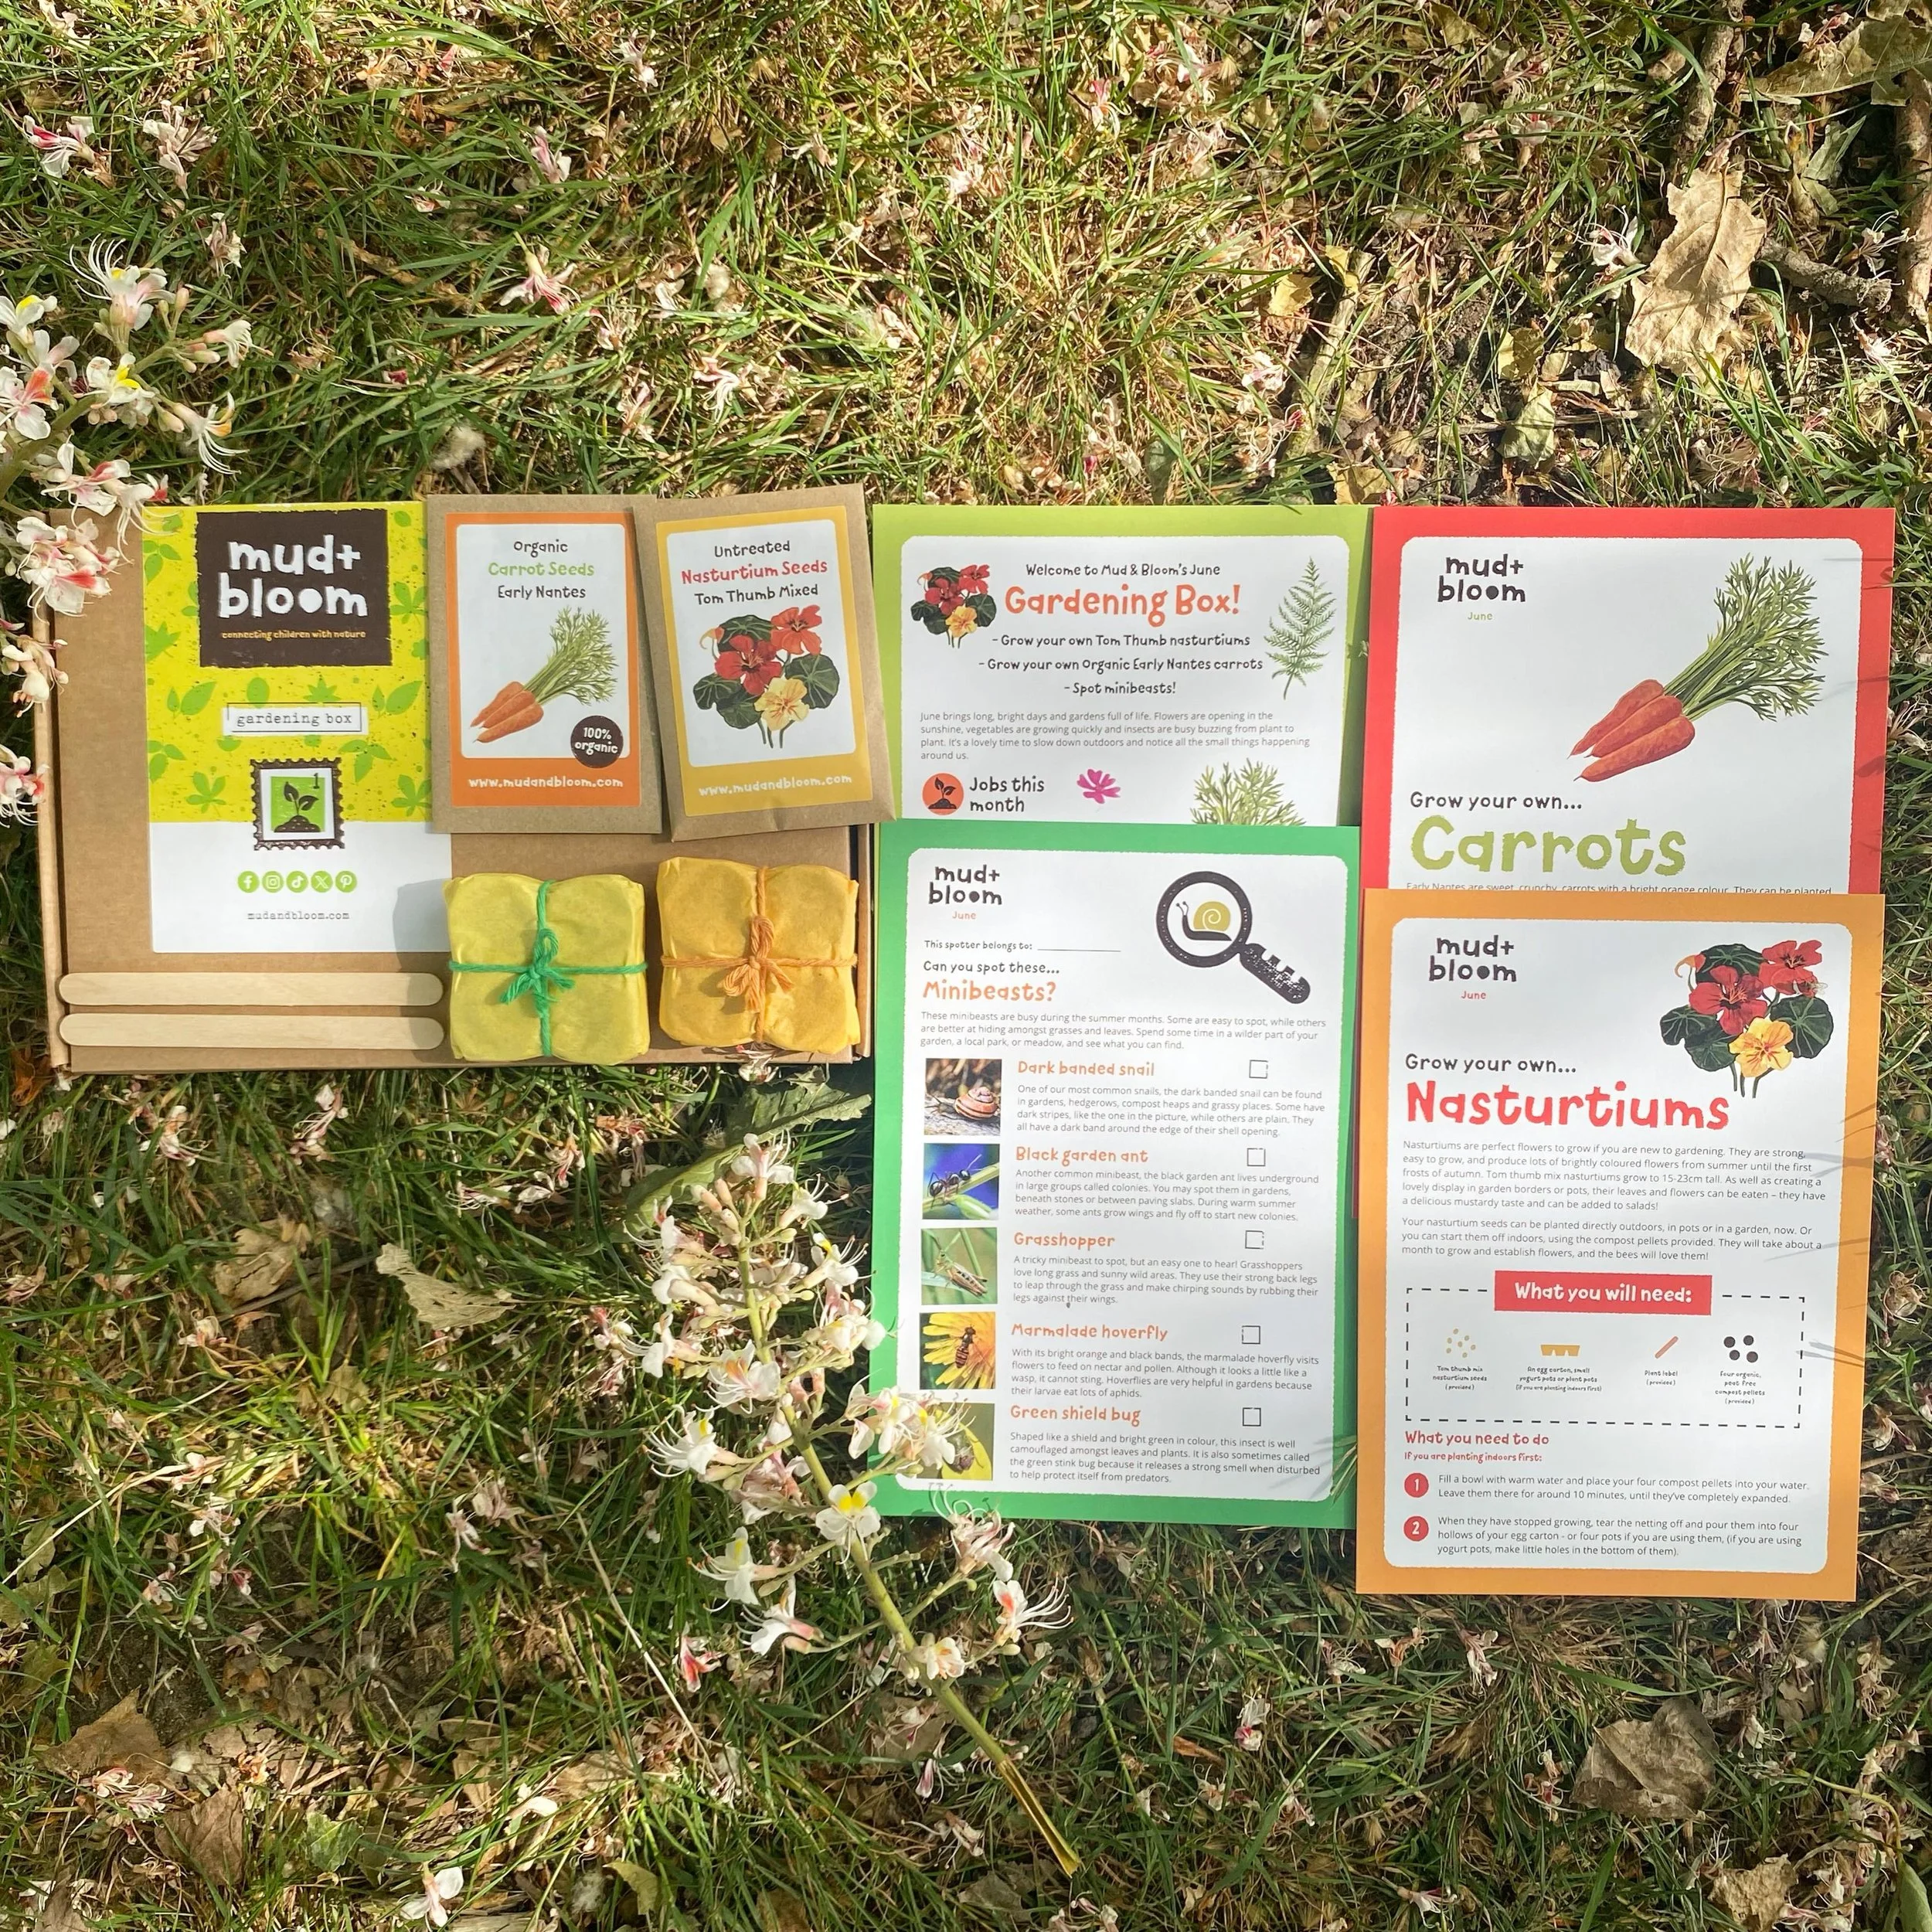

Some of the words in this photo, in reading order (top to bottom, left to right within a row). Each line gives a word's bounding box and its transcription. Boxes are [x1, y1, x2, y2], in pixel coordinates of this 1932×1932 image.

[229, 534, 361, 575] mud+
[514, 539, 568, 558] Organic
[714, 541, 791, 558] Untreated
[488, 562, 545, 576] Carrot
[549, 562, 594, 576] Seeds
[681, 563, 778, 584] Nasturtium
[782, 560, 828, 575] Seeds
[1026, 563, 1080, 577] Welcome
[1083, 564, 1097, 576] to
[1100, 565, 1127, 576] Mud
[1131, 564, 1138, 576] &
[1190, 564, 1220, 576] June
[1446, 553, 1523, 577] mud+
[218, 572, 368, 618] bloom
[498, 585, 532, 600] Early
[536, 585, 586, 598] Nantes
[695, 594, 723, 605] Tom
[726, 587, 776, 603] Thumb
[779, 583, 818, 598] Mixed
[1437, 575, 1526, 603] bloom
[1005, 583, 1168, 628] Gardening
[1175, 584, 1240, 615] Box!
[1468, 611, 1493, 621] June
[222, 630, 272, 641] connecting
[274, 629, 310, 638] children
[311, 629, 332, 638] with
[334, 630, 366, 638] nature
[1001, 634, 1034, 646] Grow
[1036, 638, 1066, 648] your
[1069, 638, 1093, 646] own
[1095, 635, 1121, 646] Tom
[1124, 634, 1167, 646] Thumb
[1170, 633, 1250, 646] nasturtiums
[988, 658, 1020, 670] Grow
[1022, 662, 1053, 672] your
[1055, 662, 1079, 670] own
[1082, 658, 1130, 675] Organic
[1133, 658, 1164, 672] Early
[1167, 658, 1211, 670] Nantes
[1214, 658, 1263, 670] carrots
[1073, 682, 1102, 696] Spot
[1105, 681, 1176, 694] minibeasts!
[236, 713, 320, 727] gardening
[325, 713, 352, 724] box
[920, 713, 940, 723] June
[944, 713, 971, 723] brings
[974, 713, 995, 723] long,
[998, 713, 1024, 723] bright
[1027, 713, 1047, 723] days
[1069, 713, 1105, 723] gardens
[1108, 712, 1121, 720] full
[1124, 712, 1134, 720] of
[1136, 712, 1151, 720] life.
[1209, 713, 1244, 723] opening
[583, 727, 612, 740] 100%
[574, 741, 618, 756] organic
[468, 775, 624, 787] www.mudandbloom.com
[699, 774, 852, 796] www.mudandbloom.com
[969, 776, 1008, 793] Jobs
[1011, 775, 1044, 793] this
[970, 796, 1025, 813] month
[1410, 791, 1464, 808] Grow
[1469, 796, 1518, 811] your
[1523, 796, 1582, 810] own...
[1411, 815, 1687, 876] Carrots
[935, 864, 1000, 883] mud+
[928, 882, 1002, 905] bloom
[247, 911, 350, 920] mudandbloom.com
[952, 911, 977, 920] June
[924, 940, 943, 949] This
[945, 941, 981, 951] spotter
[982, 941, 1016, 953] belongs
[1437, 935, 1515, 957] mud+
[923, 961, 947, 972] Can
[951, 964, 973, 973] you
[977, 962, 1005, 975] spot
[1009, 961, 1060, 974] these...
[1428, 955, 1517, 982] bloom
[923, 979, 1056, 1002] Minibeasts?
[1461, 990, 1487, 1000] June
[1018, 1060, 1054, 1074] Dark
[1060, 1061, 1114, 1075] banded
[1119, 1062, 1155, 1077] snail
[1405, 1053, 1458, 1071] Grow
[1464, 1057, 1512, 1073] your
[1517, 1058, 1577, 1074] own...
[1406, 1080, 1730, 1130] Nasturtiums
[1016, 1146, 1058, 1161] Black
[1062, 1147, 1117, 1166] garden
[1121, 1150, 1148, 1163] ant
[1014, 1232, 1115, 1252] Grasshopper
[1515, 1282, 1565, 1299] What
[1567, 1288, 1602, 1302] you
[1605, 1283, 1637, 1301] will
[1641, 1287, 1692, 1303] need:
[1012, 1323, 1097, 1338] Marmalade
[1101, 1325, 1168, 1342] hoverfly
[1011, 1404, 1057, 1420] Green
[1062, 1405, 1107, 1421] shield
[1111, 1406, 1141, 1427] bug
[1405, 1430, 1443, 1444] What
[1446, 1434, 1472, 1446] you
[1475, 1433, 1509, 1445] need
[1512, 1433, 1530, 1445] to
[1532, 1434, 1549, 1445] do
[1447, 1452, 1485, 1464] planting
[1485, 1452, 1517, 1461] indoors
[1022, 1471, 1041, 1481] help
[1043, 1472, 1075, 1481] protect
[1078, 1471, 1100, 1480] itself
[1101, 1472, 1123, 1481] from
[1413, 1478, 1420, 1492] 1
[1438, 1489, 1465, 1498] Leave
[1468, 1489, 1492, 1498] them
[1495, 1489, 1519, 1498] there
[1522, 1489, 1535, 1498] for
[1537, 1490, 1571, 1498] around
[1587, 1491, 1627, 1501] minutes,
[1630, 1492, 1650, 1500] until
[1688, 1492, 1739, 1504] completely
[1742, 1495, 1791, 1504] expanded.
[1411, 1521, 1420, 1535] 2
